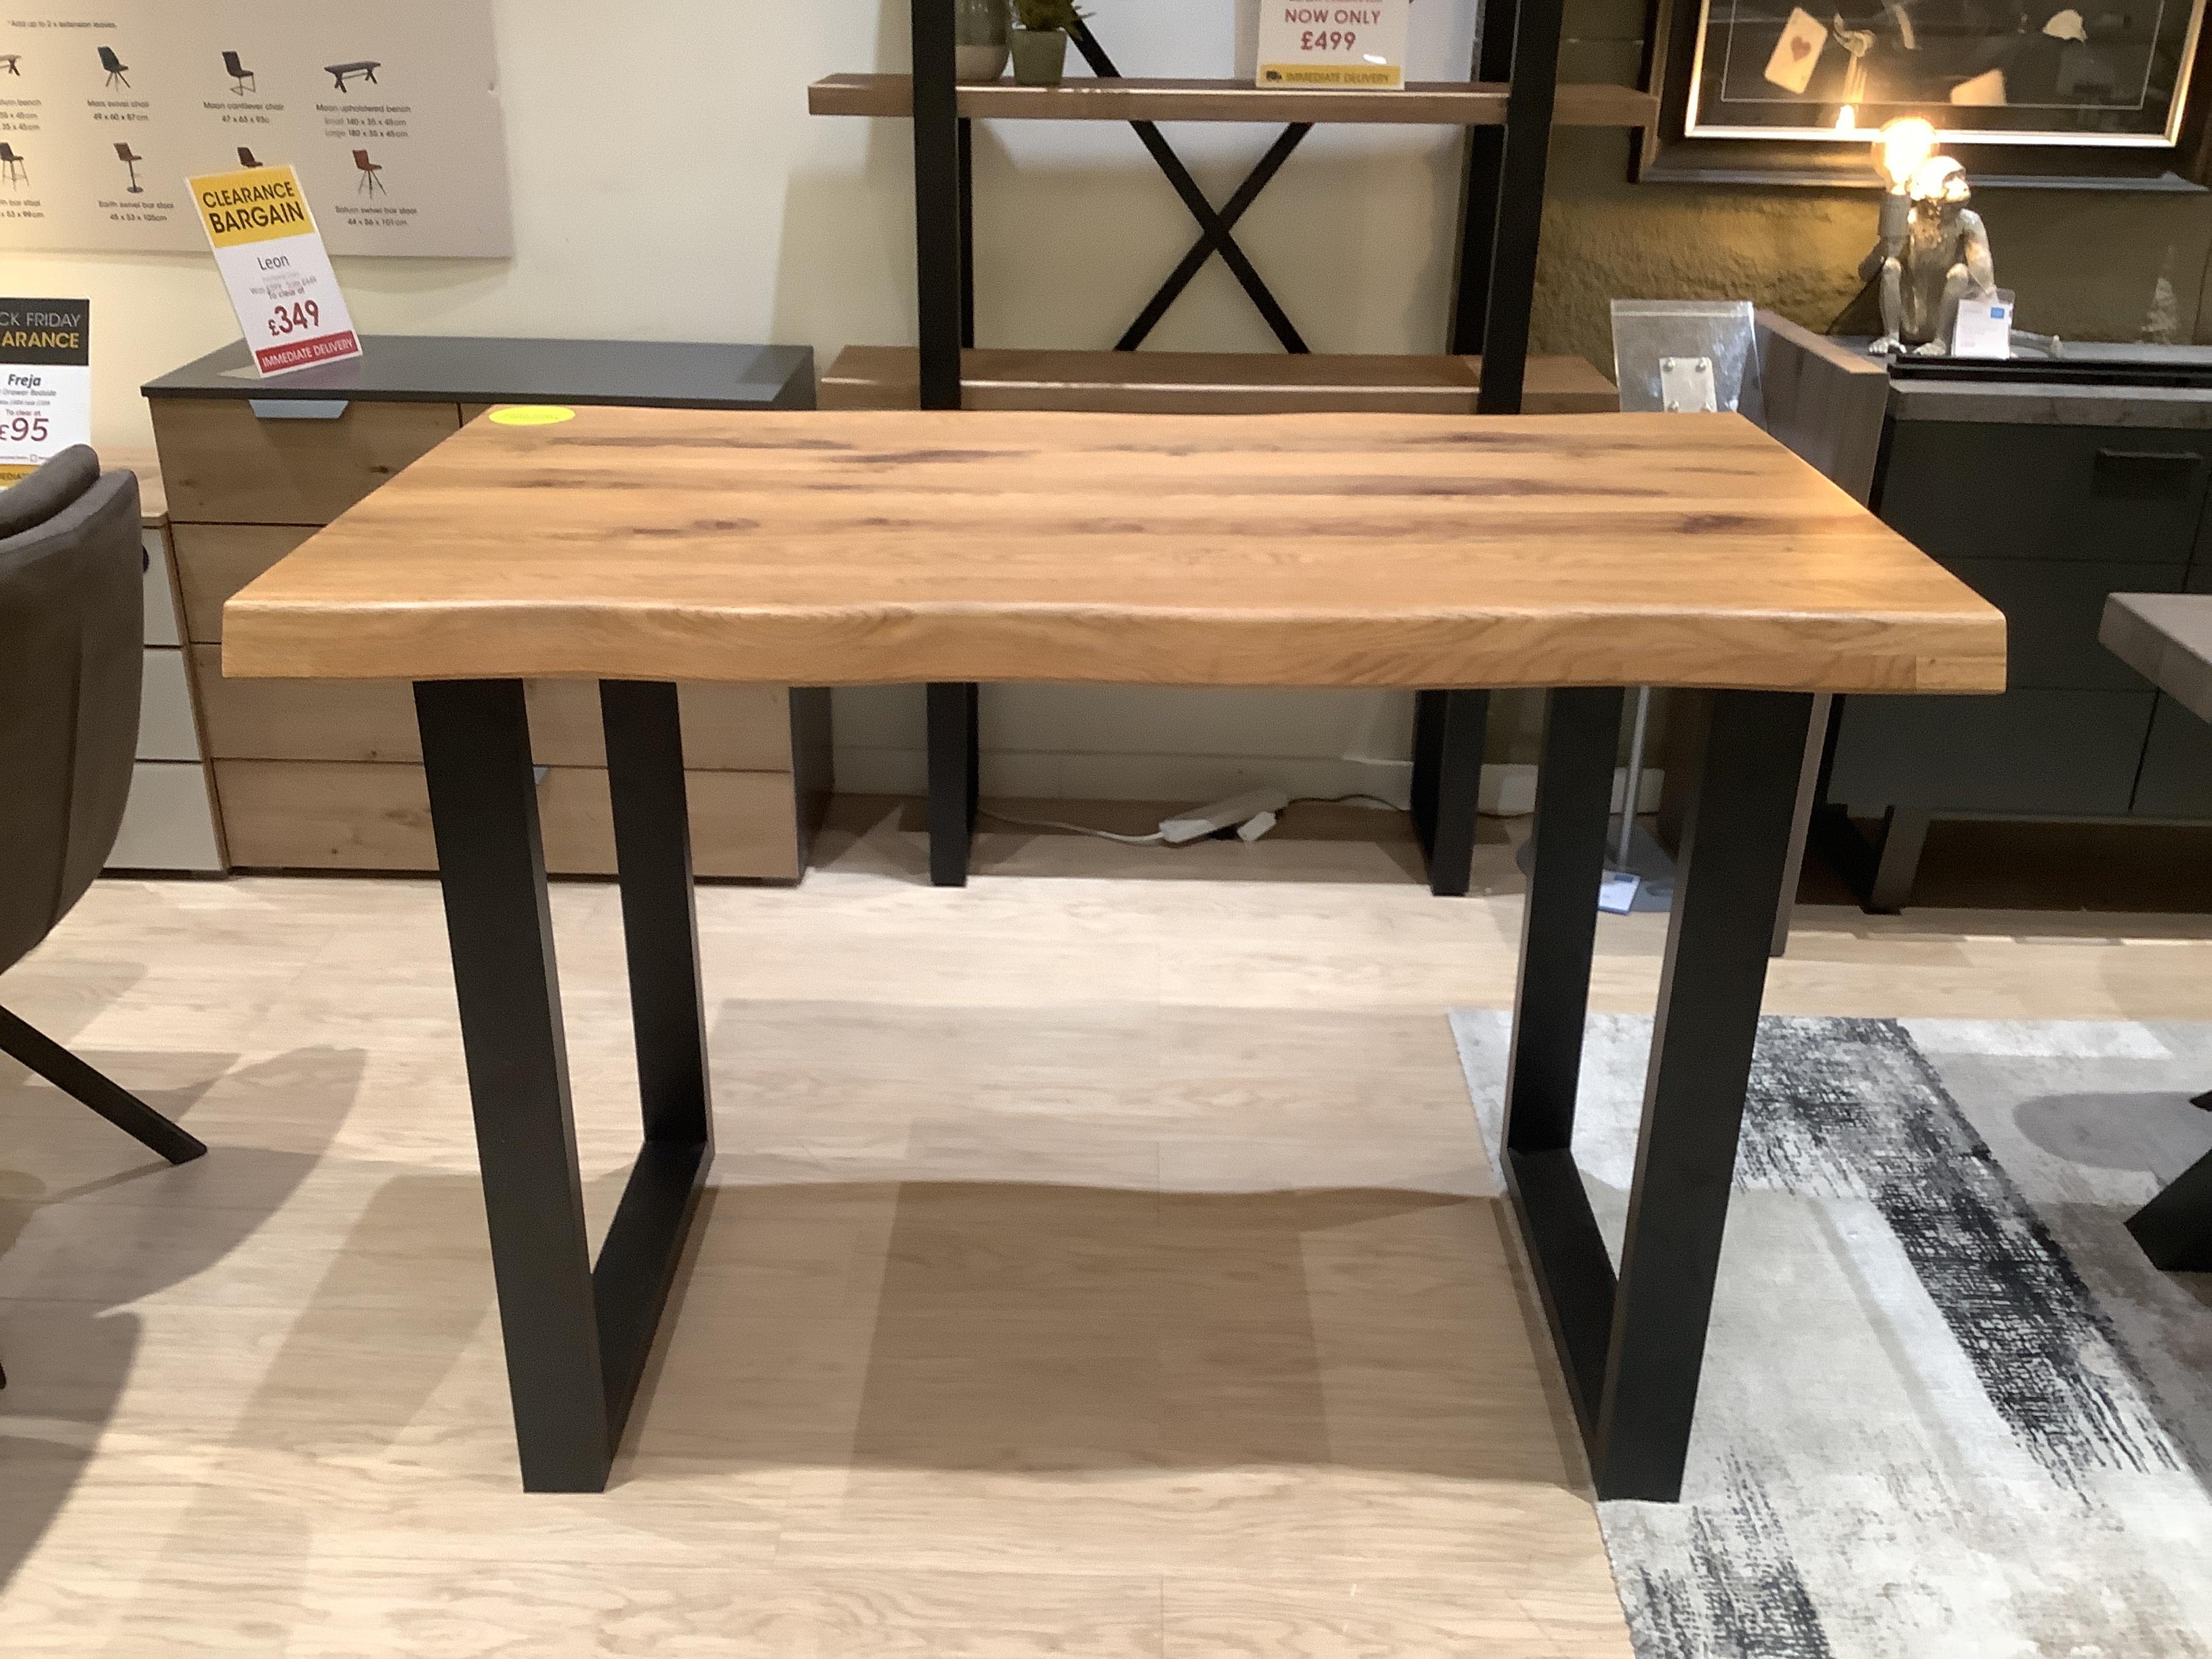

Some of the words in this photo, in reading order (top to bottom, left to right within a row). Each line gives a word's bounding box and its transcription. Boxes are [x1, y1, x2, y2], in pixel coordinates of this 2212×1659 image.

[1285, 9, 1328, 23] NOW
[1334, 9, 1380, 24] ONLY
[1300, 30, 1356, 51] £499
[203, 182, 295, 208] CLEARANCE
[209, 201, 305, 234] BARGAIN
[257, 255, 290, 271] Leon
[0, 312, 20, 326] CK
[26, 312, 81, 327] FRIDAY
[268, 300, 320, 336] £349
[1, 330, 80, 349] ARANCE
[262, 347, 312, 368] IMMEDIATE
[313, 337, 353, 356] DELIVERY
[7, 374, 41, 388] Freja
